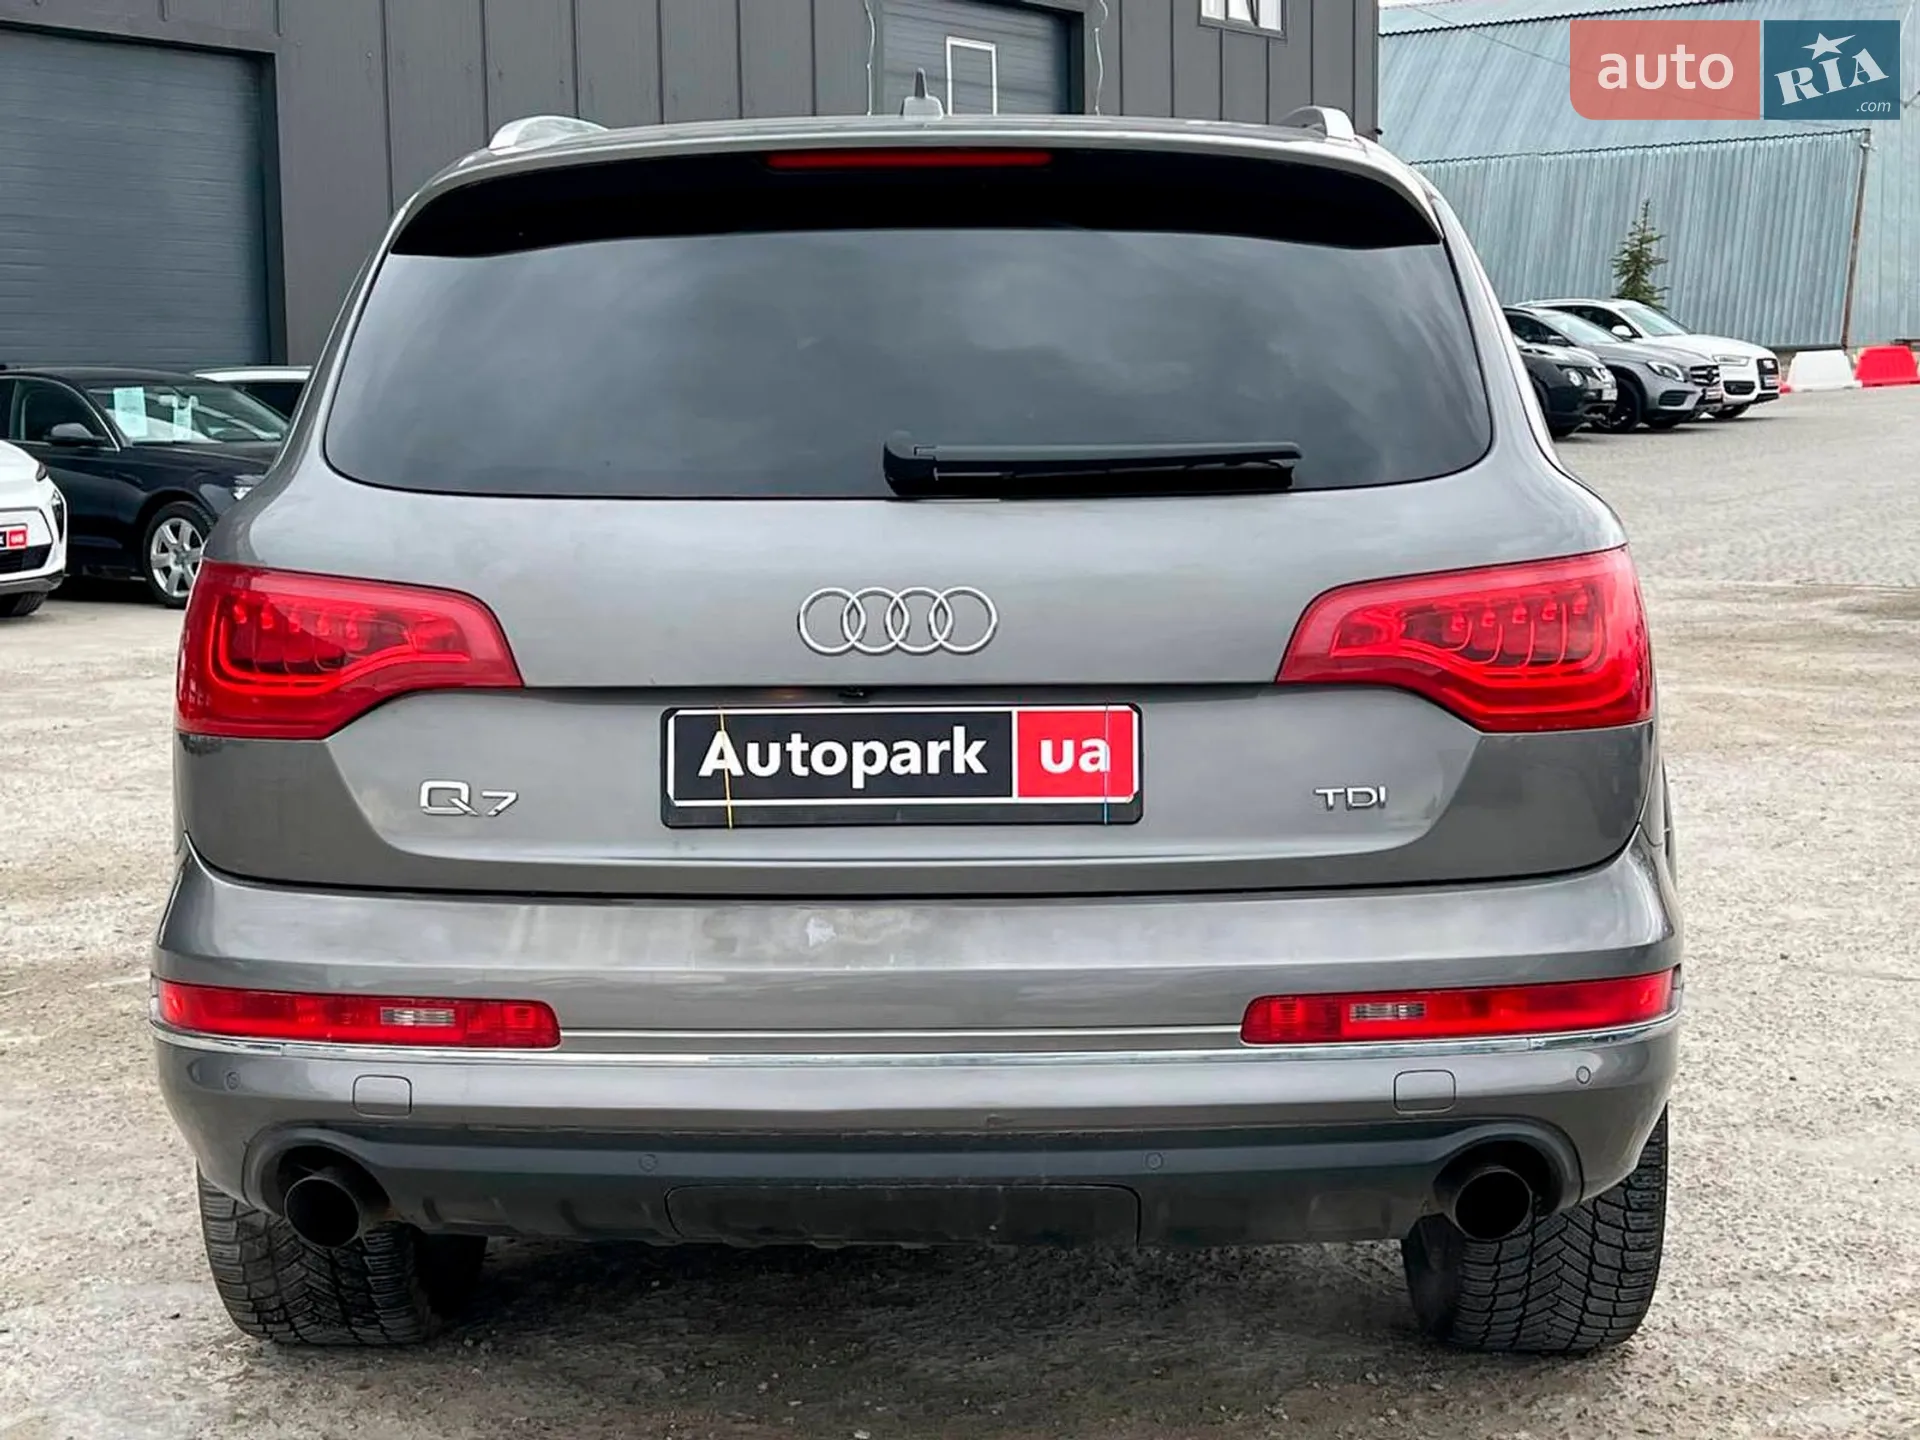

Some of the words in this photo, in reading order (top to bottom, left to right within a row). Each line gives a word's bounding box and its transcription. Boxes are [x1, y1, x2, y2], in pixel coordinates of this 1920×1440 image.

[699, 726, 988, 789] Autopark
[1039, 737, 1111, 774] ua
[420, 779, 518, 817] Q7
[1314, 785, 1387, 810] TDI
